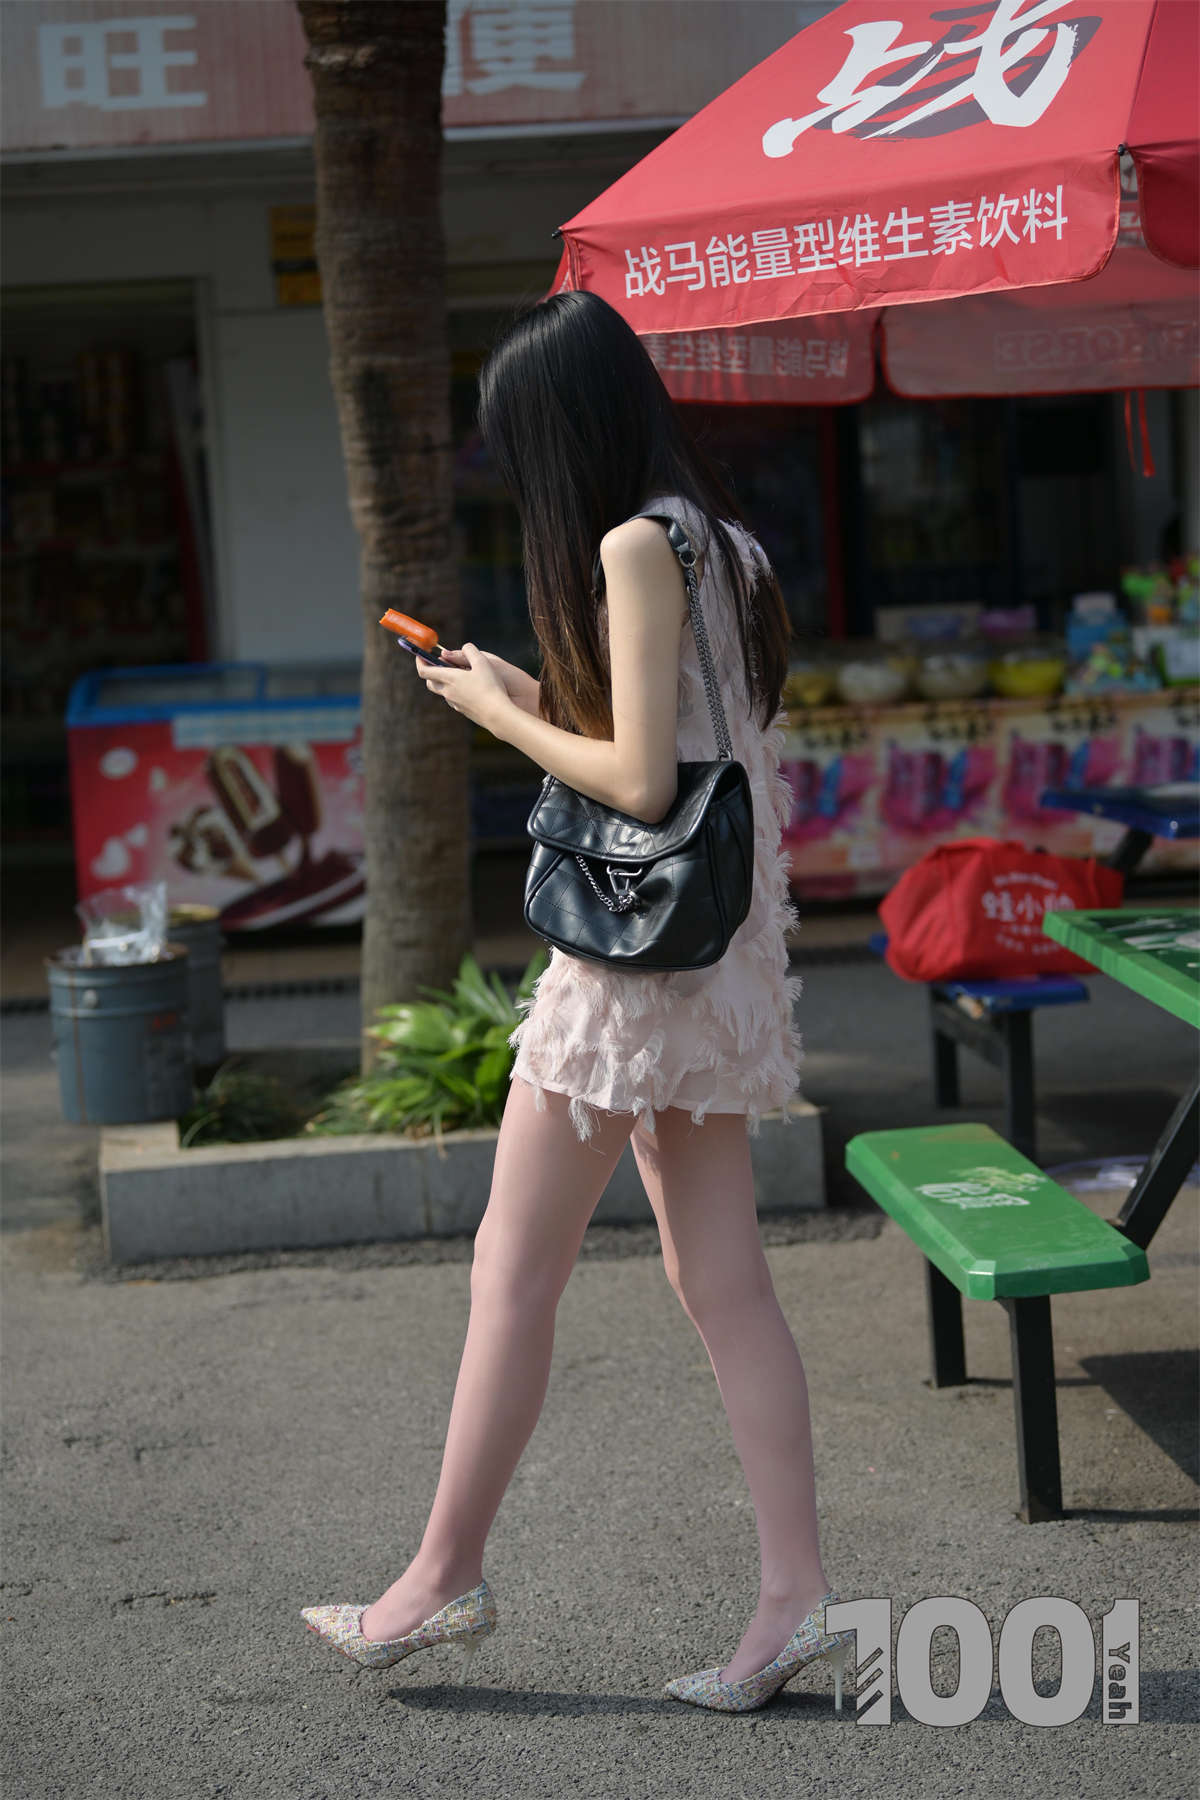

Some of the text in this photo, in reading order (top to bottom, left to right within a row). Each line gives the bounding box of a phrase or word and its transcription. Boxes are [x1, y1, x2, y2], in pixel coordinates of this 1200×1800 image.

[38, 16, 208, 110] 旺
[623, 184, 1069, 299] 战马能量型维生素饮料
